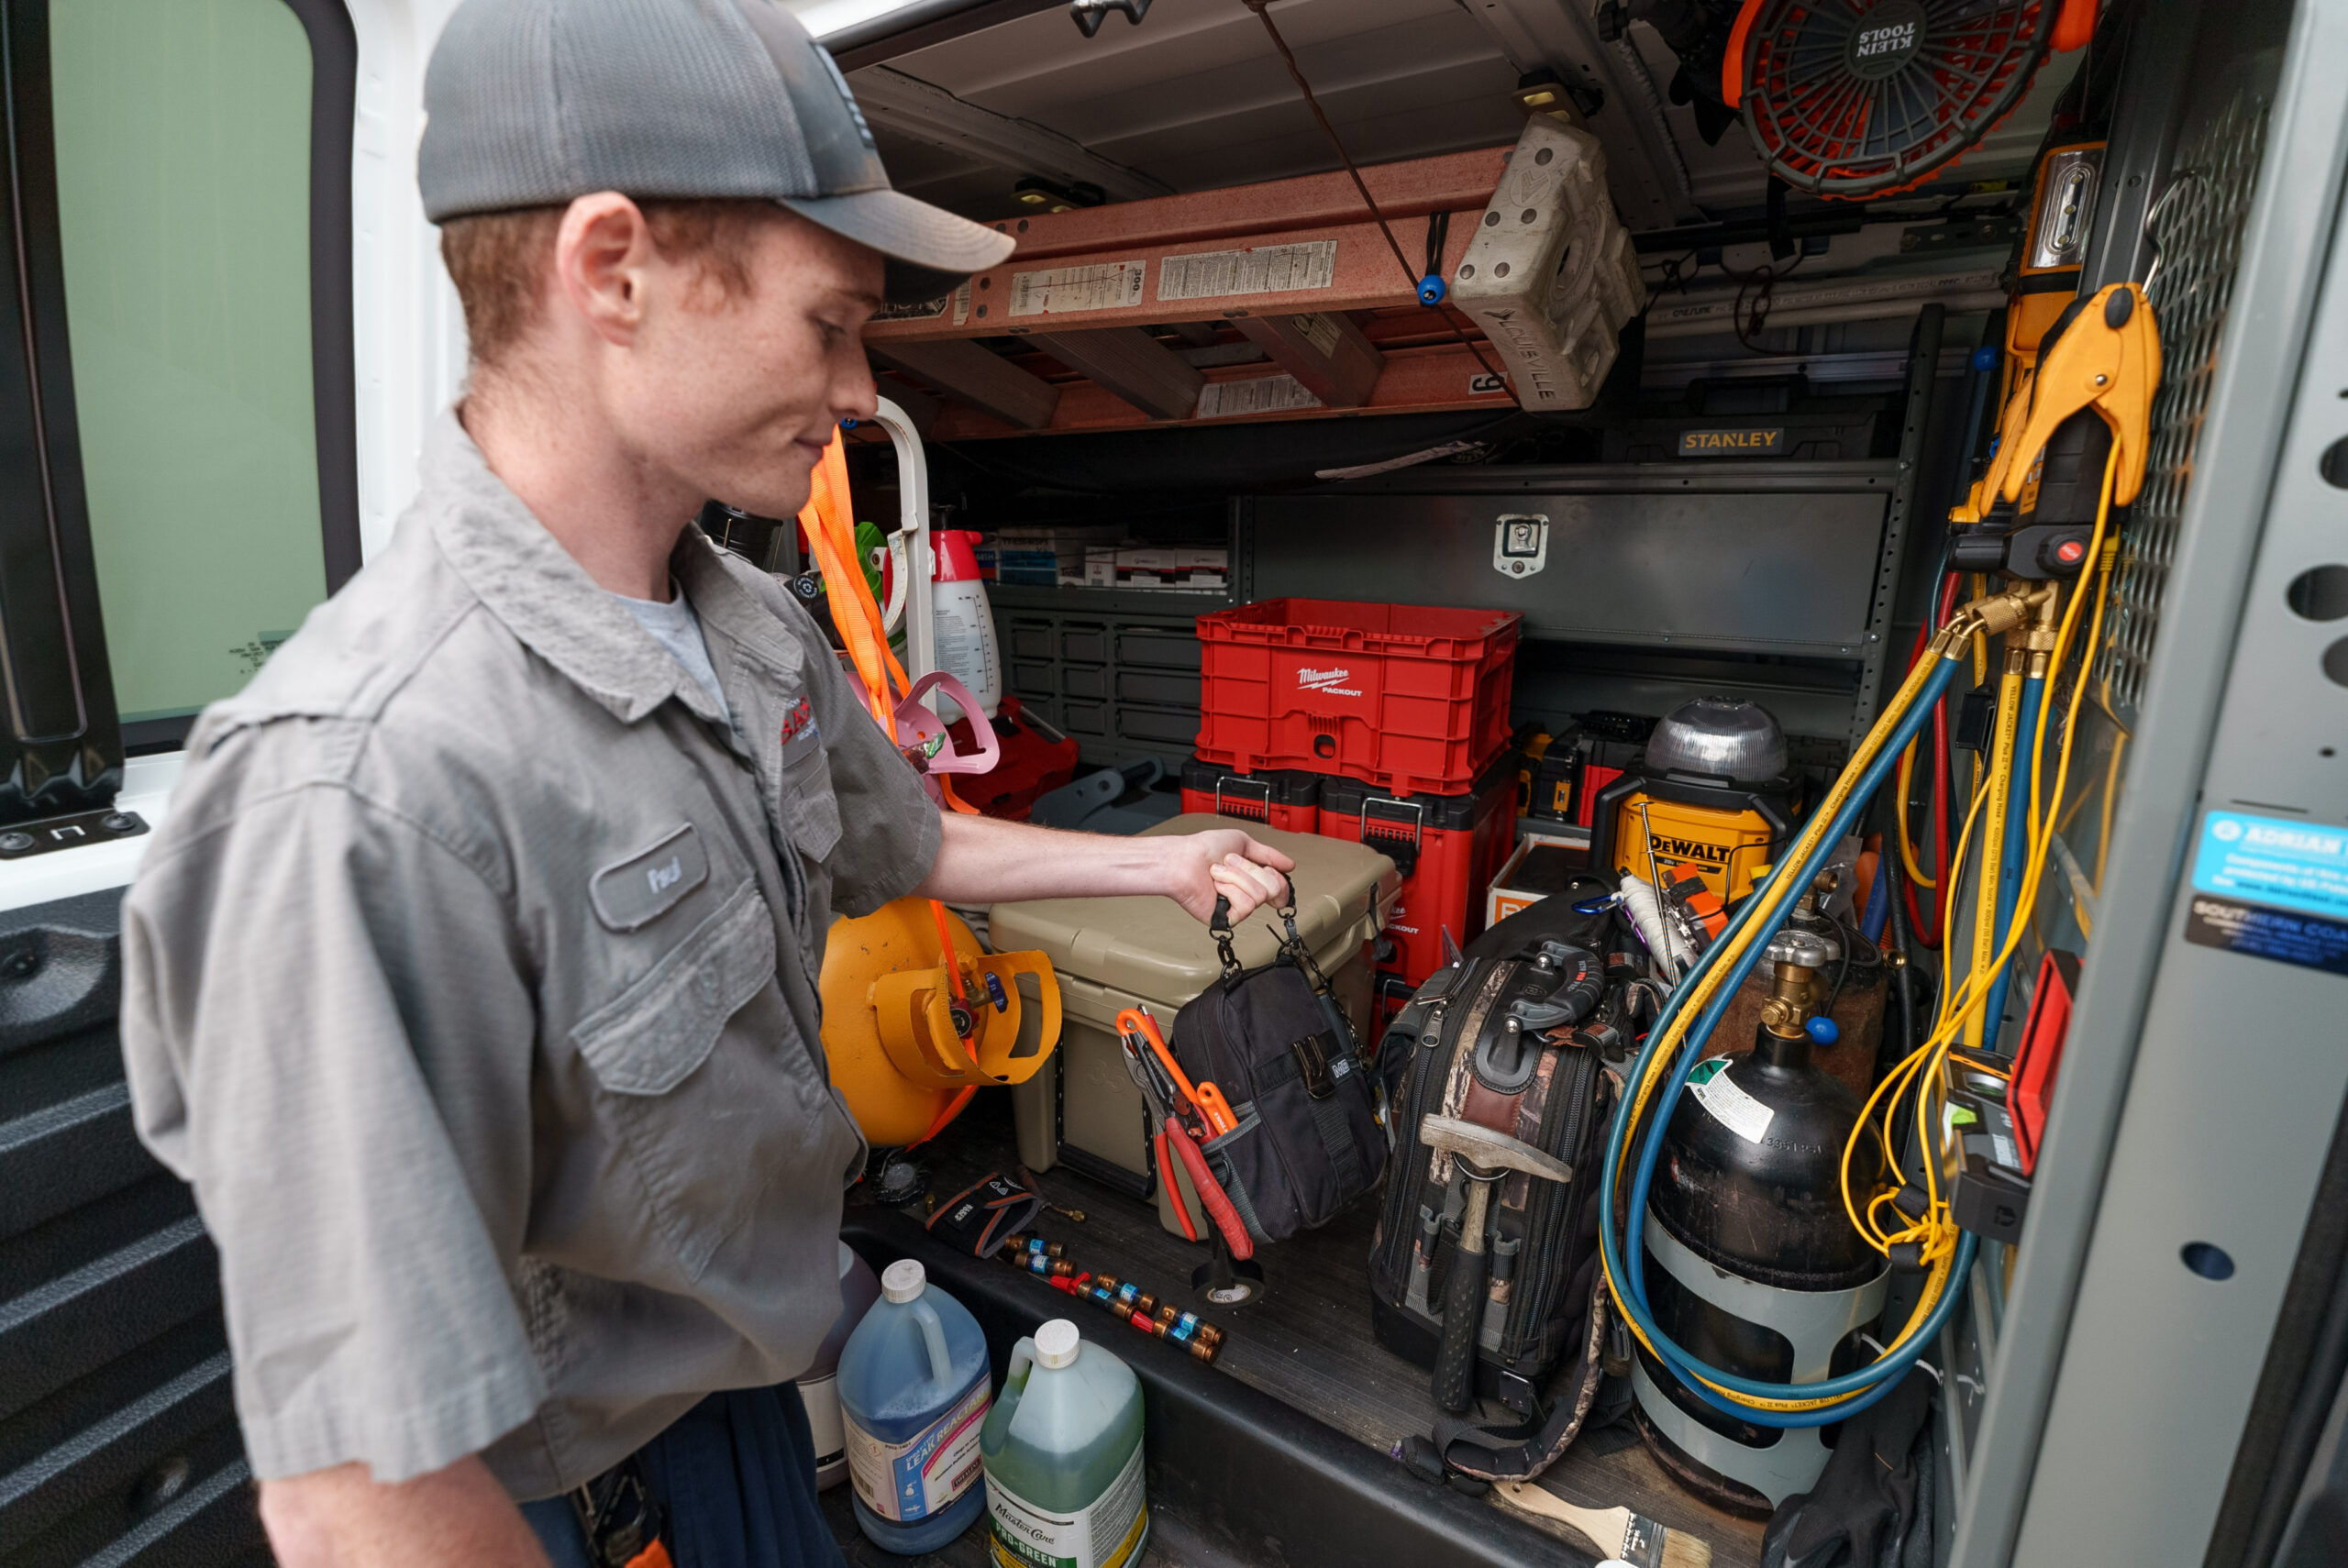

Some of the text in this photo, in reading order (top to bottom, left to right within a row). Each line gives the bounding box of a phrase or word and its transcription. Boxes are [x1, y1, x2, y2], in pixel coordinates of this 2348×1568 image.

[1858, 22, 1915, 44] TOOLS
[1856, 36, 1914, 57] KLEIN
[1498, 320, 1557, 401] LOUISVILLE
[1685, 431, 1778, 448] STANLEY
[1297, 668, 1349, 684] Milwaukee
[1322, 687, 1363, 697] PACKOUT
[2008, 685, 2017, 711] YELLOW
[1830, 784, 1847, 810] Charging
[1844, 770, 1855, 785] Hose
[1996, 773, 2006, 801] Charging
[2245, 826, 2342, 854] ADRIAN
[1386, 922, 1420, 933] CKOUT
[1725, 1392, 1755, 1405] Charging
[906, 1441, 936, 1472] LEAK
[936, 1390, 989, 1441] REACTAN
[996, 1521, 1057, 1567] PRO-GREEN
